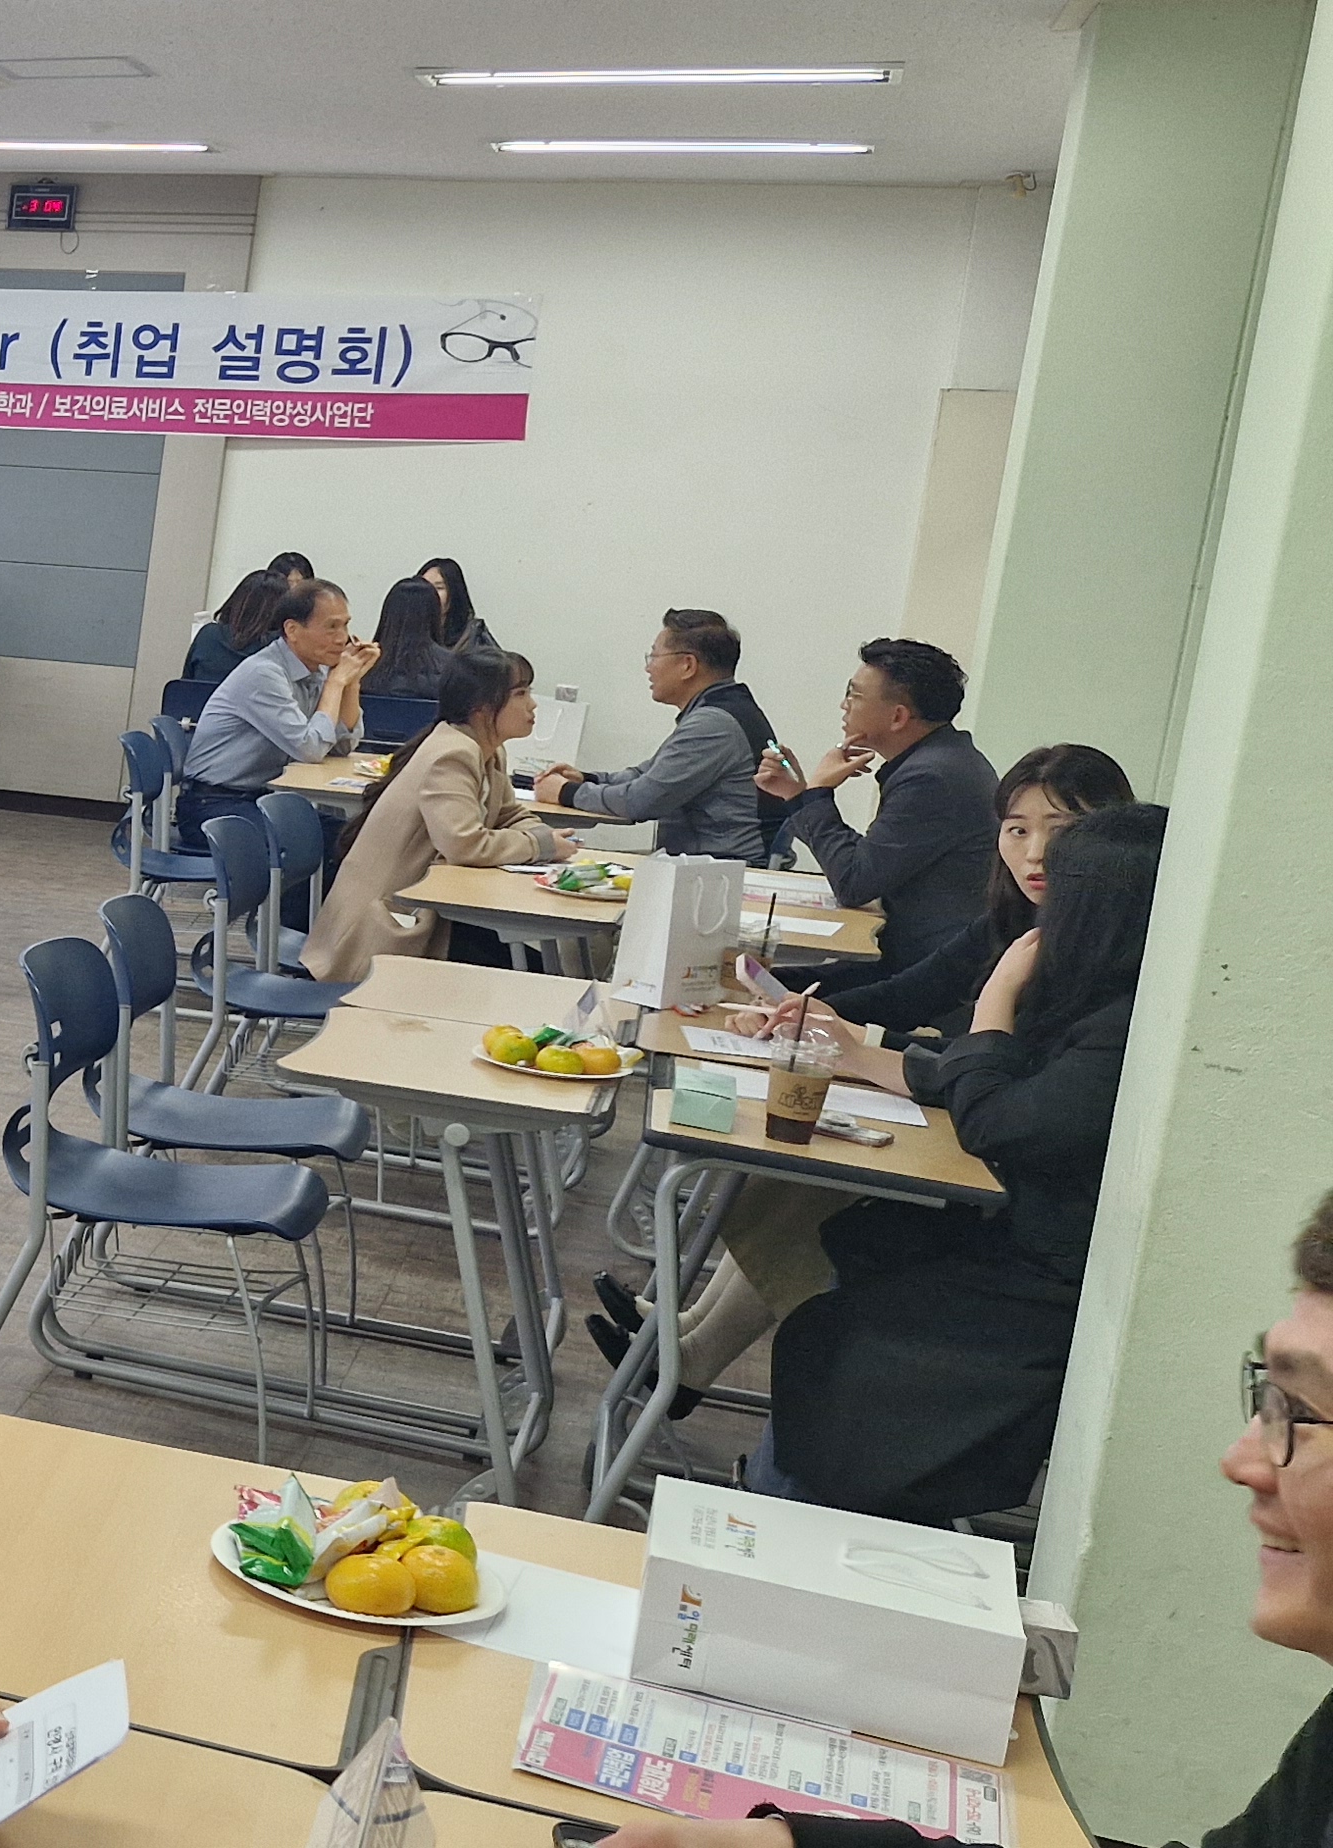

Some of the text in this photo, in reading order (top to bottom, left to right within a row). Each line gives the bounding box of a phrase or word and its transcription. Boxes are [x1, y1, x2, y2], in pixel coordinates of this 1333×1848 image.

[49, 318, 180, 380] (취업
[211, 323, 413, 388] 설명회)
[52, 394, 186, 422] 보건의료서비스
[192, 397, 374, 429] 전문인력양성사업단
